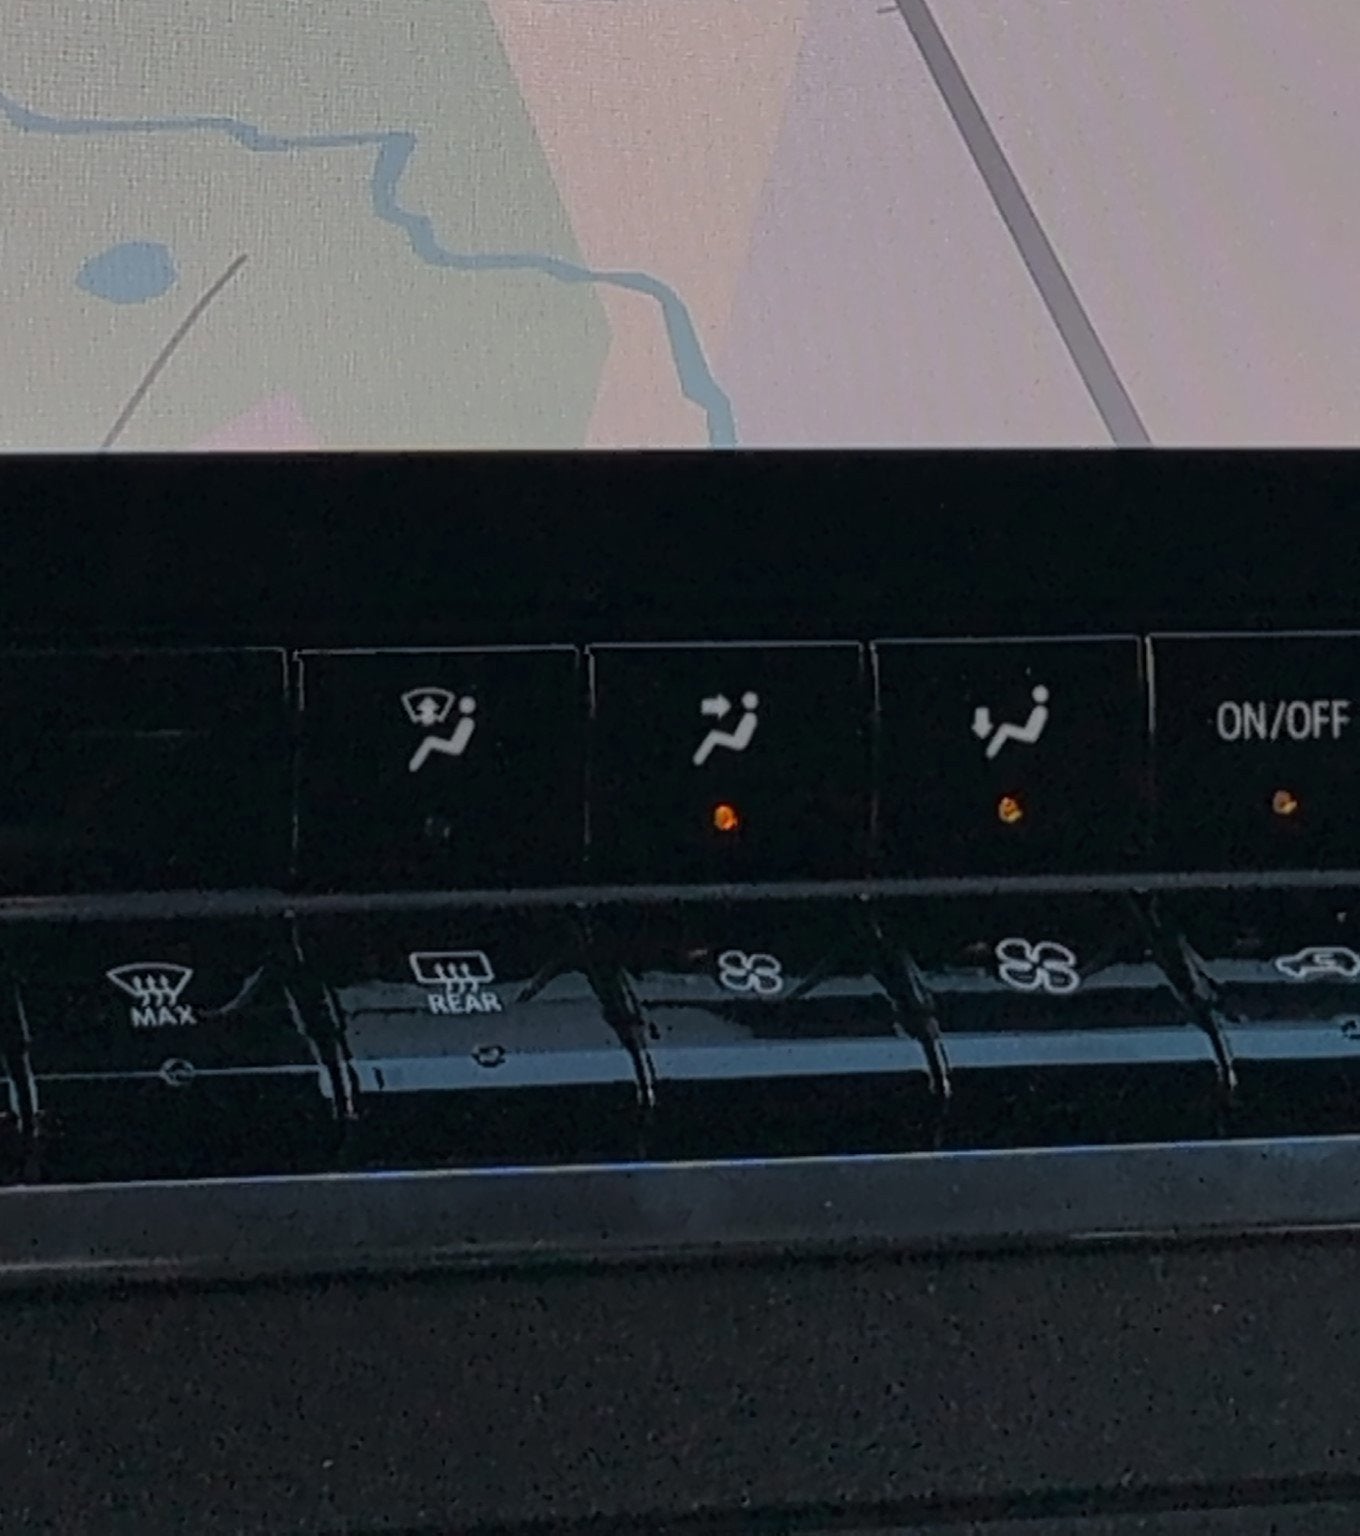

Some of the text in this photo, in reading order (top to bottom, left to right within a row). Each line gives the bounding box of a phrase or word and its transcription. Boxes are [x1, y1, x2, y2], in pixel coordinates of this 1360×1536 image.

[1216, 700, 1351, 741] ON/OFF
[427, 992, 502, 1014] REAR
[130, 1005, 197, 1028] MAX
